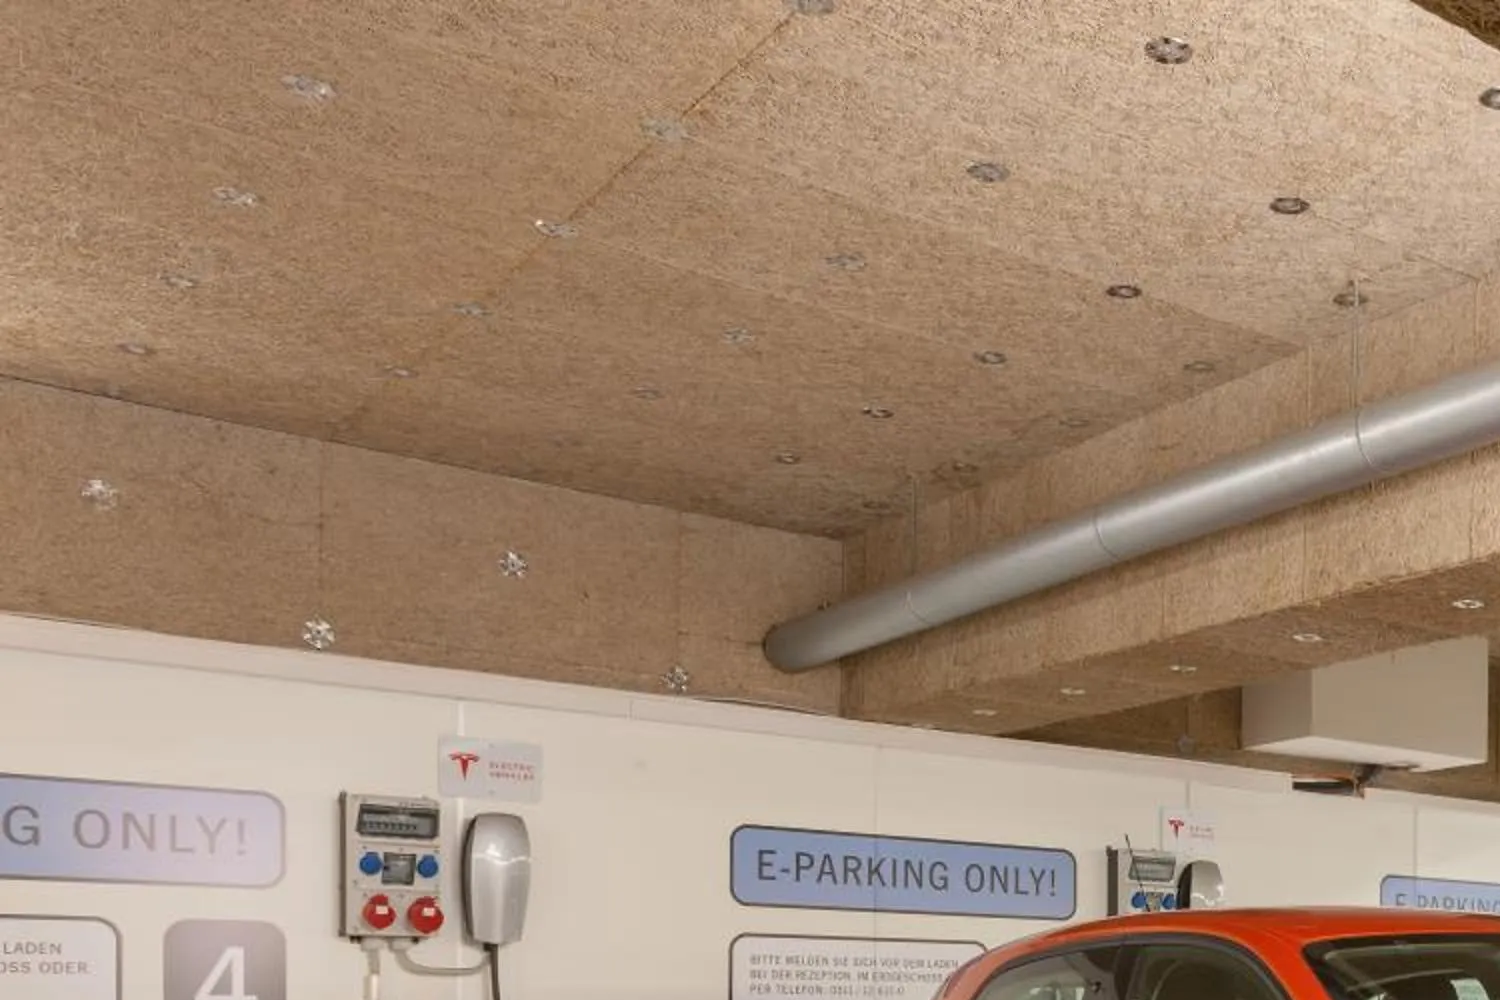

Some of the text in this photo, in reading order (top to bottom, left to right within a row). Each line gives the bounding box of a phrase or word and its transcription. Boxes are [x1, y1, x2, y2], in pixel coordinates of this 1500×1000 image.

[73, 808, 247, 856] ONLY!
[757, 849, 1057, 897] E-PARKING ONLY!
[3, 941, 62, 955] LADEN
[38, 961, 89, 975] ODER
